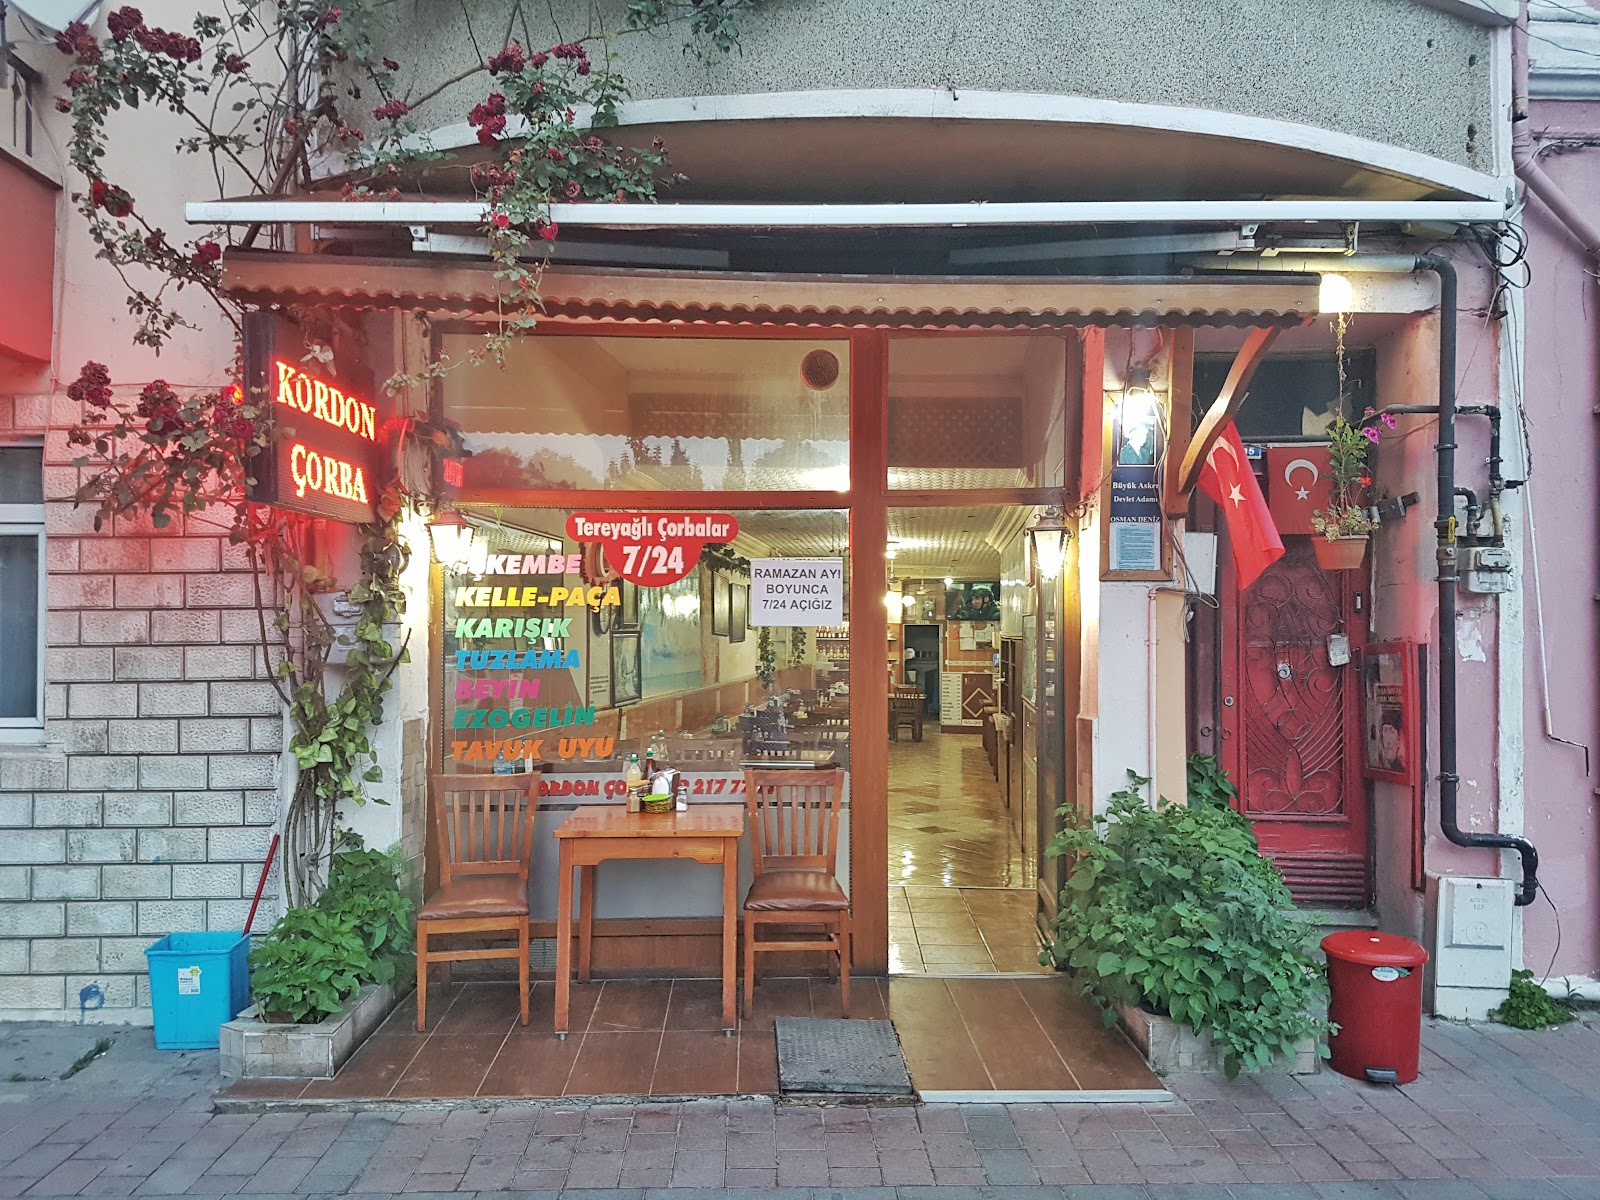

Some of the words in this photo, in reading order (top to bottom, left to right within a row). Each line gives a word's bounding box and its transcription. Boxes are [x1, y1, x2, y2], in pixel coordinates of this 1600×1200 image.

[290, 443, 369, 504] ÇORBA
[1112, 481, 1136, 491] Büyük
[574, 516, 651, 540] Tereyağlı
[657, 516, 730, 542] Çorbalar
[1138, 515, 1160, 523] DENİZ
[622, 545, 685, 577] 7/24
[754, 568, 817, 579] RAMAZAN
[820, 568, 841, 579] AYI
[454, 586, 621, 613] KELLE-PAÇA
[766, 584, 829, 595] BOYUNCA
[762, 599, 787, 610] 7/24
[790, 597, 832, 612] AÇIĞIZ
[454, 617, 573, 645] KARIŞIK
[454, 648, 581, 670] TUZLAMA
[454, 673, 541, 700] BEYİN
[452, 701, 596, 729] EZOGELİN
[450, 739, 545, 761] TAVUK
[558, 737, 615, 759] UYU
[523, 779, 600, 797] ORDON
[692, 778, 728, 795] 217
